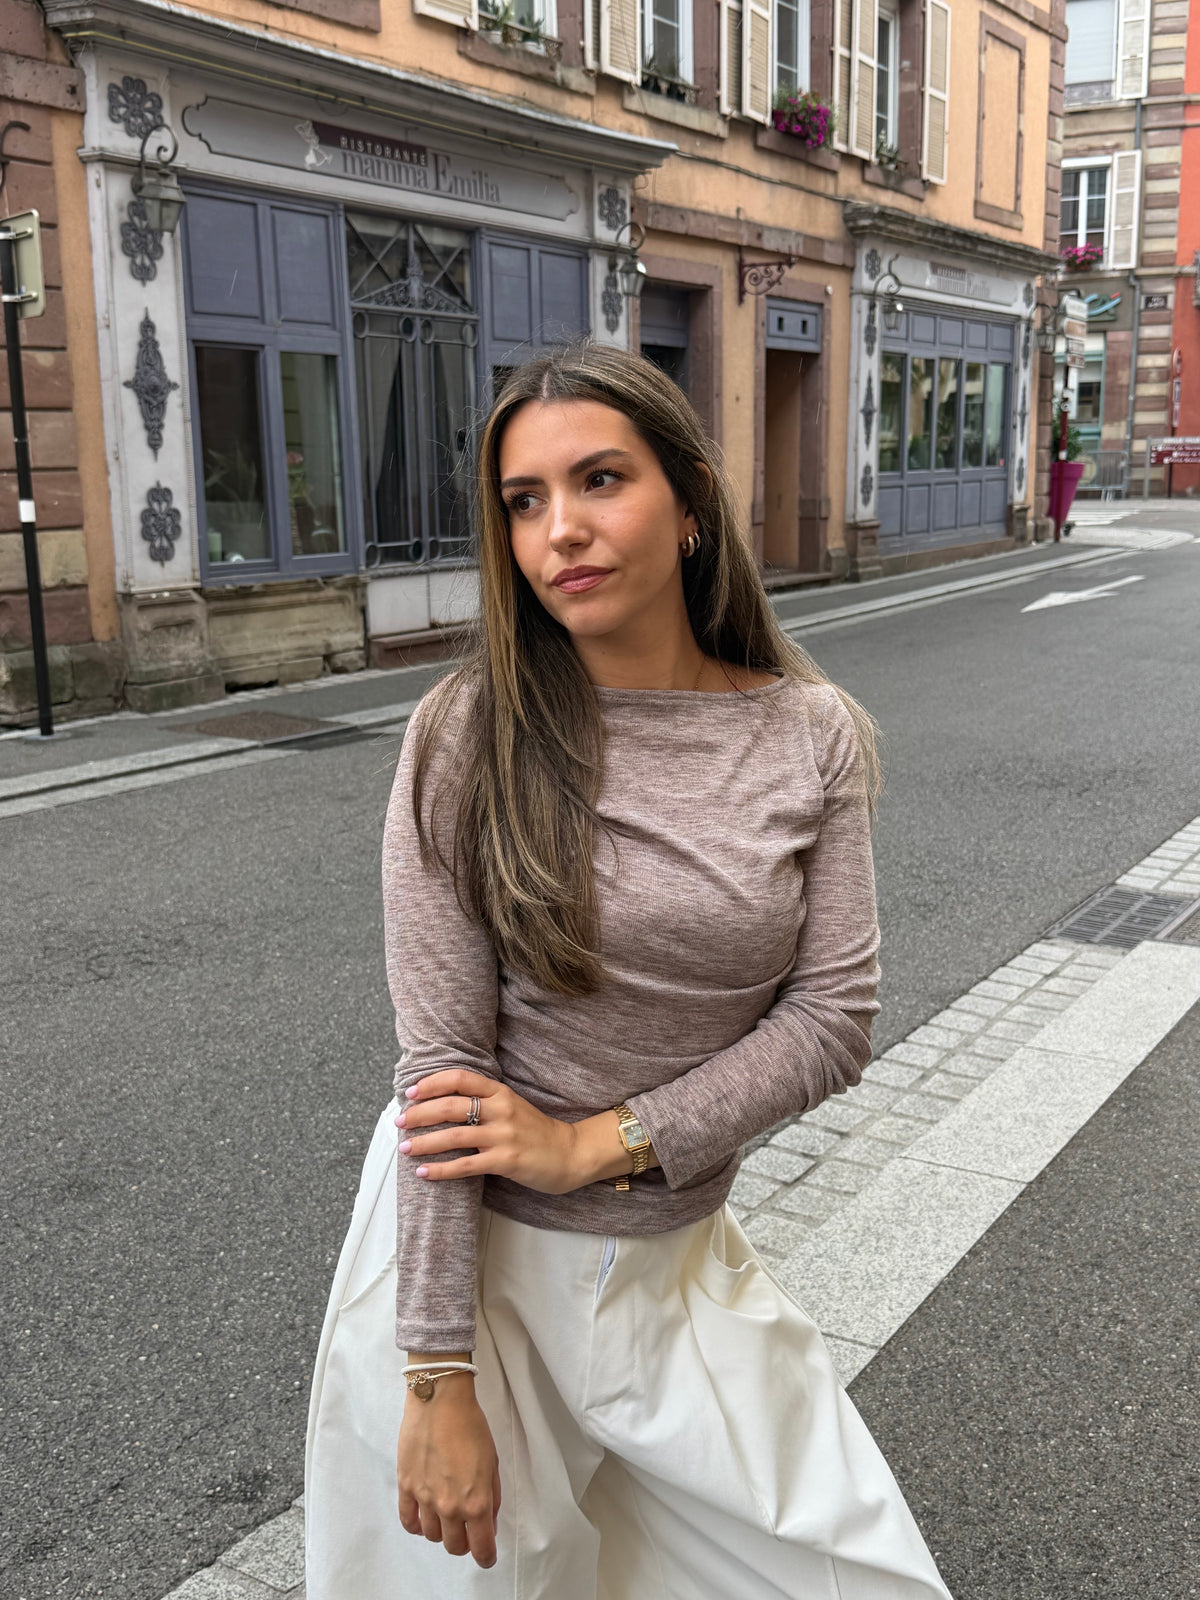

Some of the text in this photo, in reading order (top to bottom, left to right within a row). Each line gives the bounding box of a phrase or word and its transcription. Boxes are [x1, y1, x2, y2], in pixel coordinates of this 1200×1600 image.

[339, 135, 427, 167] RISTORANTE
[341, 151, 500, 203] mamma Emilia
